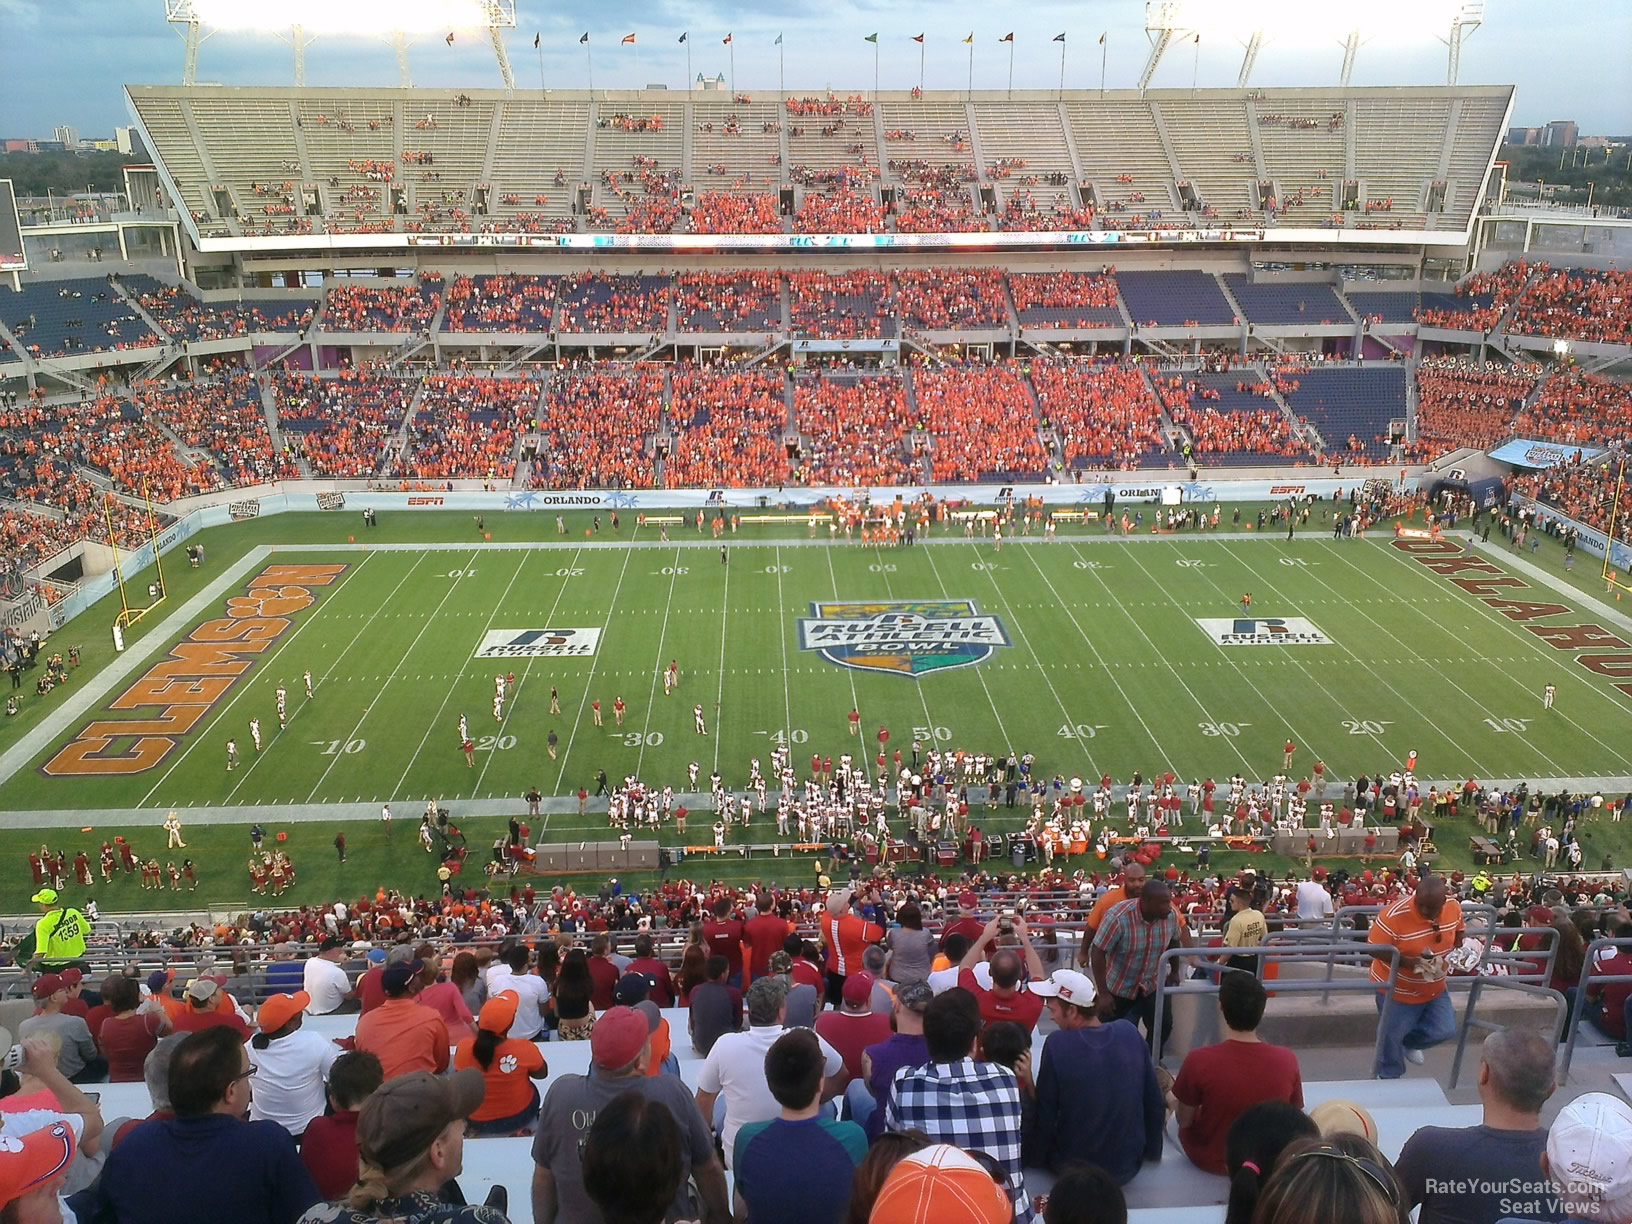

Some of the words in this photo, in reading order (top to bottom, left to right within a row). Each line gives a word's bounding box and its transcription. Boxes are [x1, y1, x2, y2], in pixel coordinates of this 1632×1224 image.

[1120, 488, 1161, 497] ORLAN
[1270, 486, 1306, 495] ESPN
[408, 497, 444, 505] ESPN
[543, 496, 601, 505] ORLANDO
[153, 532, 177, 554] OLANDO
[1578, 532, 1605, 551] LANDO
[1388, 539, 1632, 698] OKLAHO
[810, 621, 991, 634] RUSSELL
[814, 631, 996, 642] ATHLETIC
[486, 644, 590, 652] RUSSELL
[855, 641, 960, 652] BOWL
[1056, 724, 1097, 739] 40
[1198, 722, 1241, 737] 30
[1341, 720, 1385, 735] 20
[1483, 718, 1528, 733] 10
[623, 732, 665, 747] 30
[769, 729, 810, 744] 40
[912, 727, 953, 741] 50
[319, 739, 366, 755] 10
[474, 735, 518, 750] 20
[1566, 1161, 1614, 1184] Titleist
